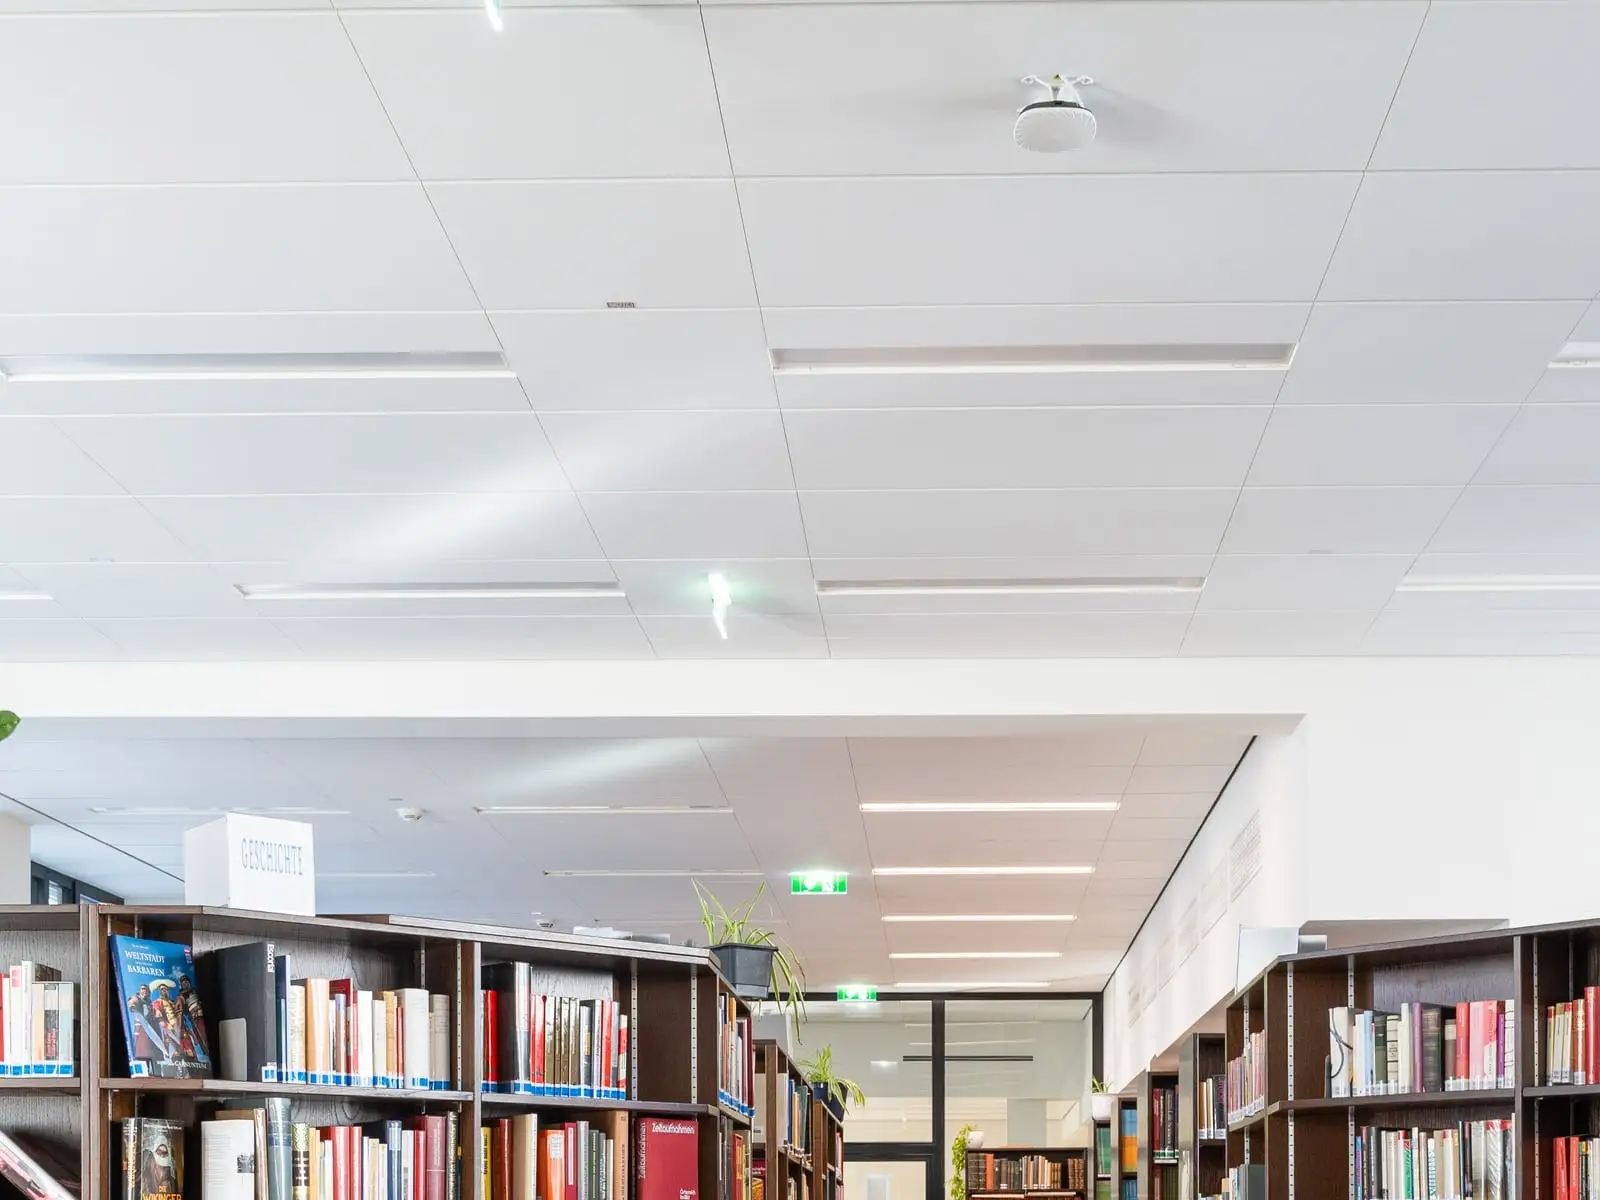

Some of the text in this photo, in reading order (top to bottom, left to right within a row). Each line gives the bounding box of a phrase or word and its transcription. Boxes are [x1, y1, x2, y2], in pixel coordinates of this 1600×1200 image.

[241, 838, 303, 875] GESCHICHTE
[124, 951, 165, 963] WELTSTADT
[128, 965, 165, 976] BARBAREN
[652, 1122, 695, 1134] Zeitaufnahmen
[159, 1185, 167, 1193] DIE
